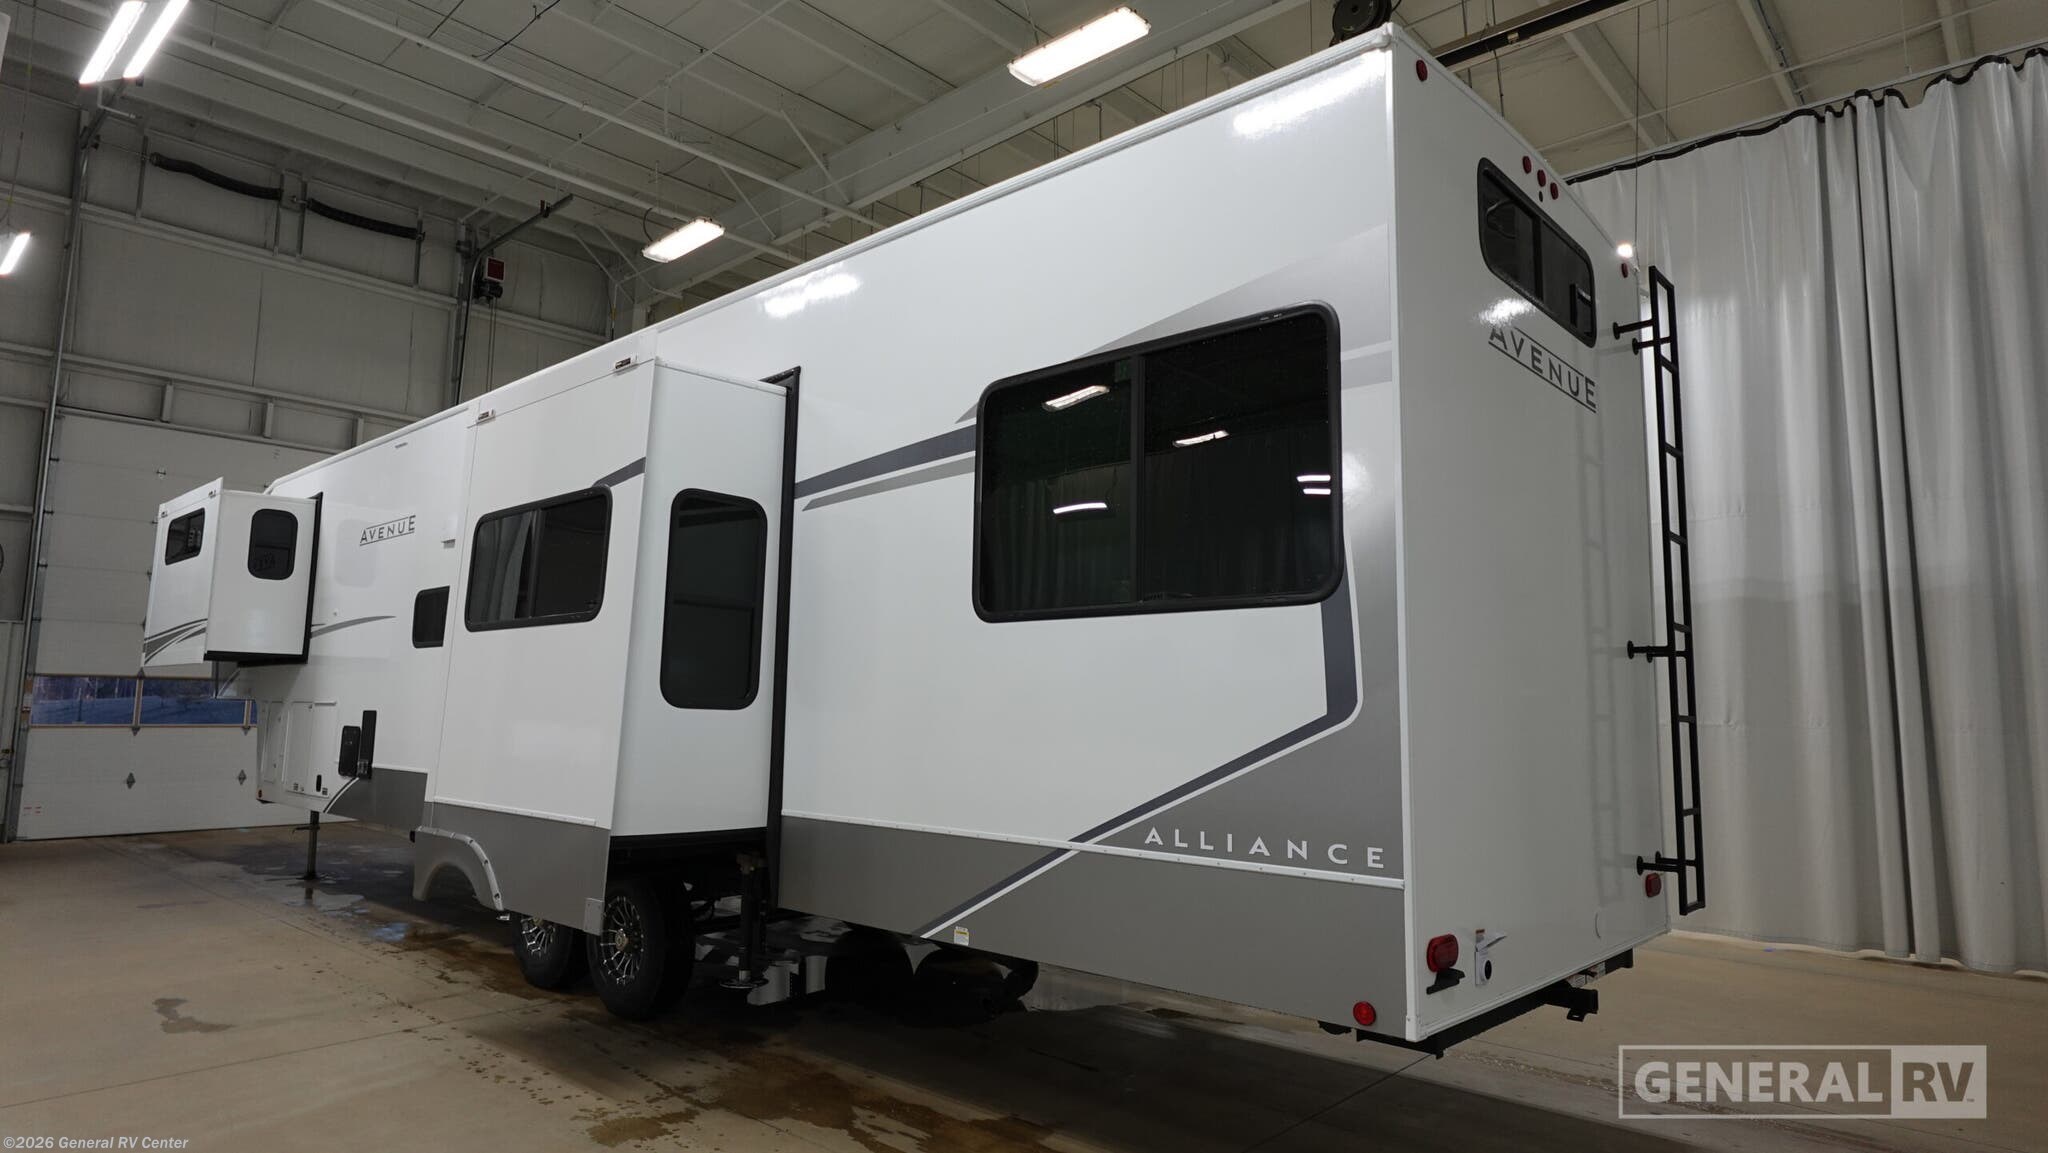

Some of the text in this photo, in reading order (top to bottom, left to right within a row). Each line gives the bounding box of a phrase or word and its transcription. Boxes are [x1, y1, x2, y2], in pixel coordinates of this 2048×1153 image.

[1489, 325, 1597, 409] AVENUE
[360, 515, 416, 543] AVENUE
[1144, 827, 1385, 869] ALLIANCE
